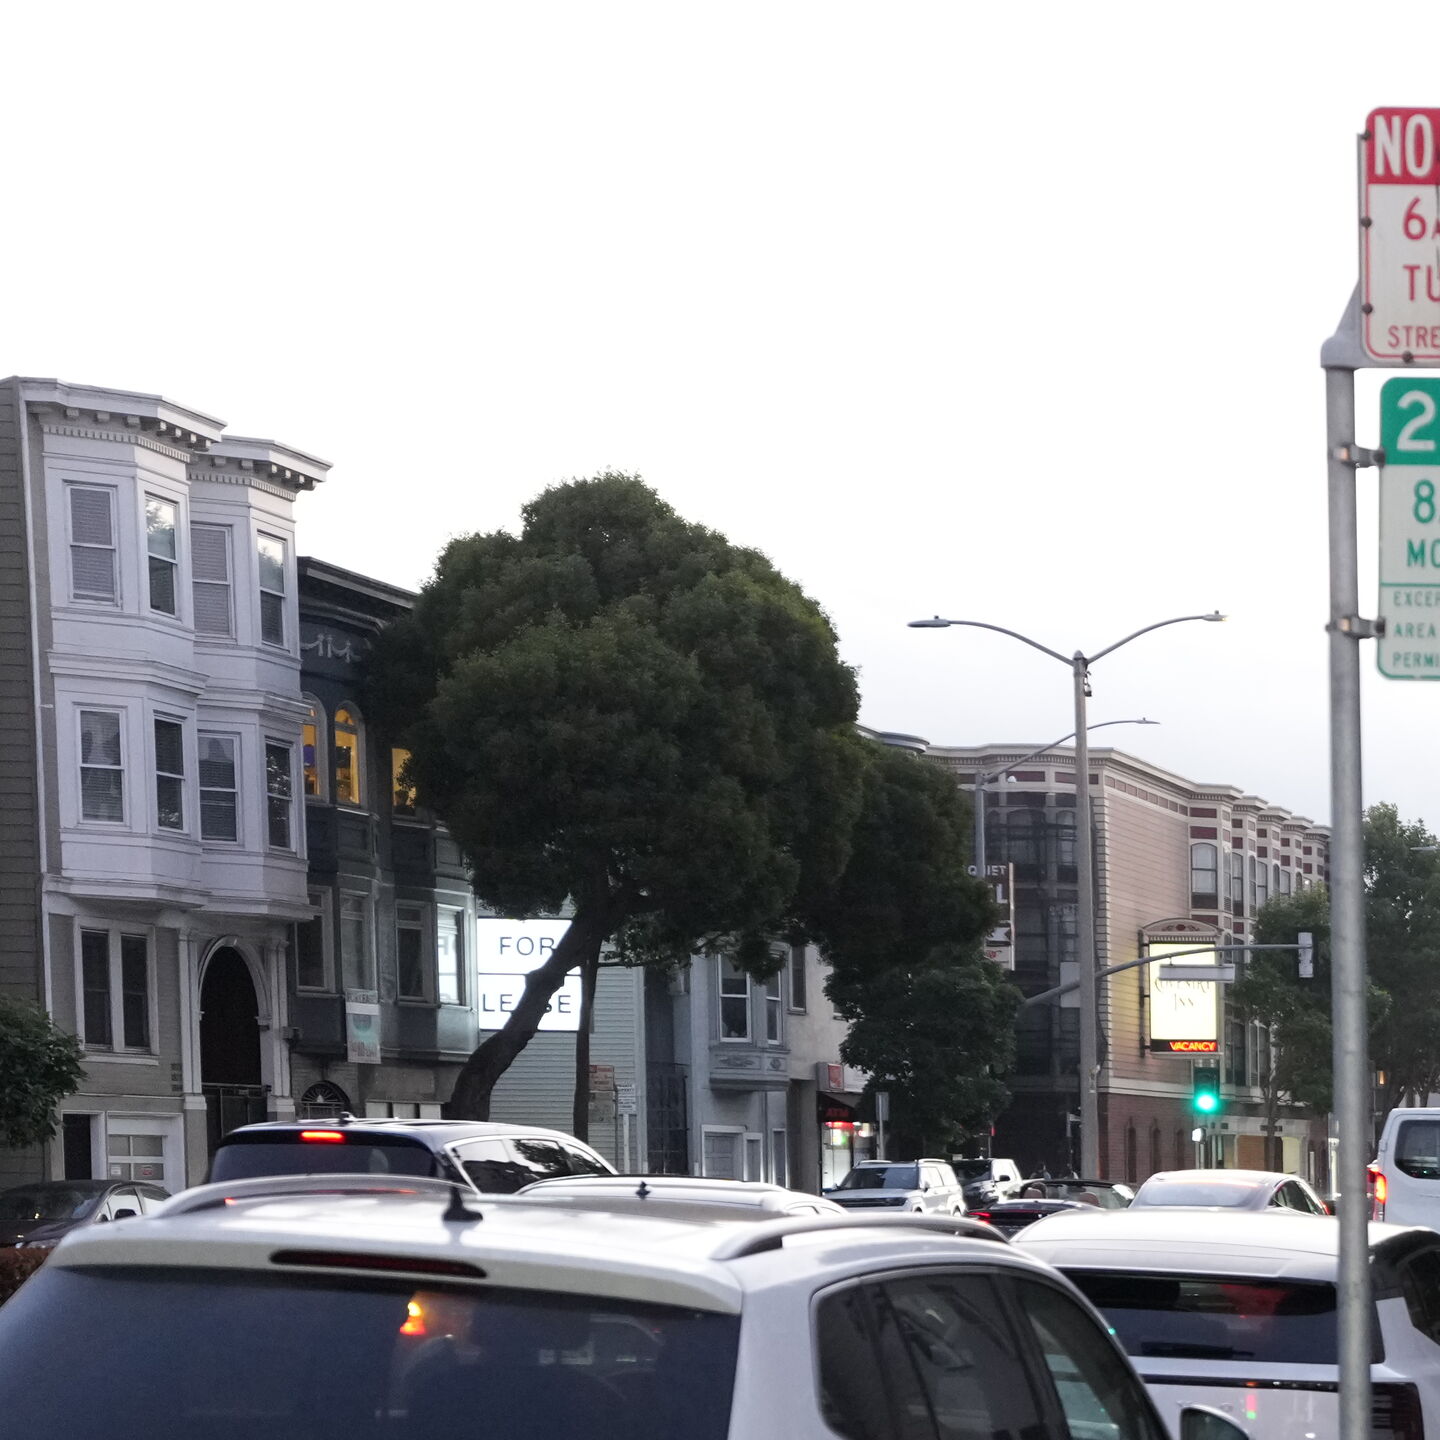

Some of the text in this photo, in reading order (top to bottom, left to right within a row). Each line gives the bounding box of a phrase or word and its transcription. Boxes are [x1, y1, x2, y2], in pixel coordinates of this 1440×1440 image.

[1374, 114, 1433, 177] NO
[1397, 389, 1436, 451] 2
[1393, 622, 1436, 638] AREA
[967, 864, 1007, 876] QIET
[500, 937, 555, 955] FOR
[482, 993, 571, 1013] LEE
[1169, 1041, 1216, 1051] VACANCY
